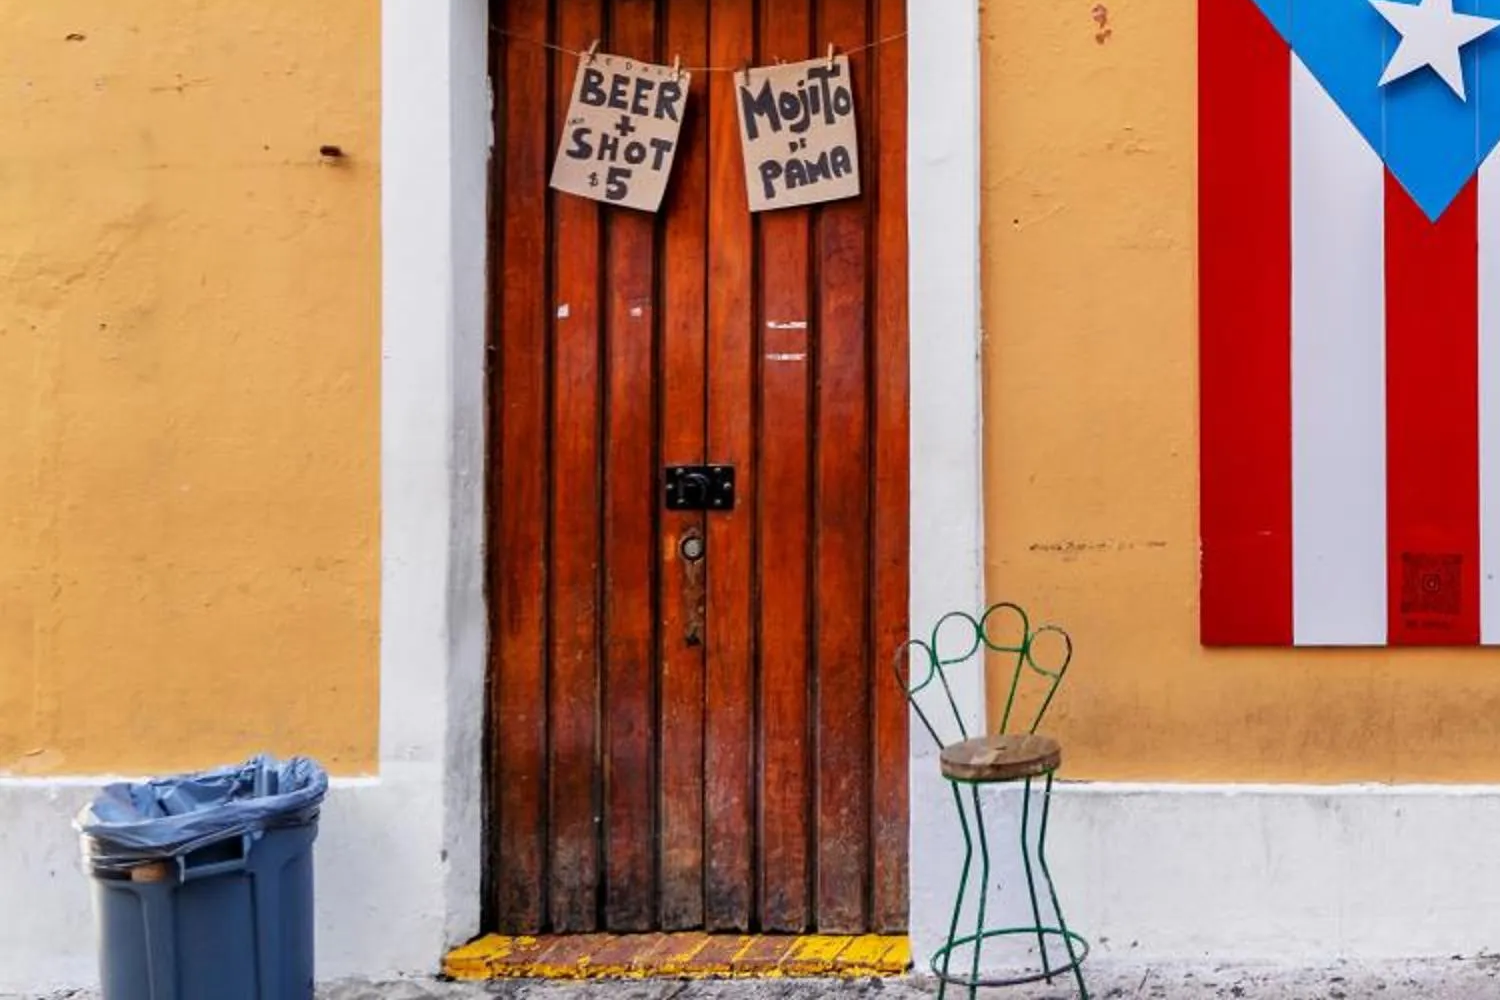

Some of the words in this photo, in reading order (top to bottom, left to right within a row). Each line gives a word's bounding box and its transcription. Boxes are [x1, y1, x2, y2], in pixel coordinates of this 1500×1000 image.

[578, 67, 682, 124] BEER
[566, 127, 675, 171] SHOT
[758, 145, 852, 199] PAMA
